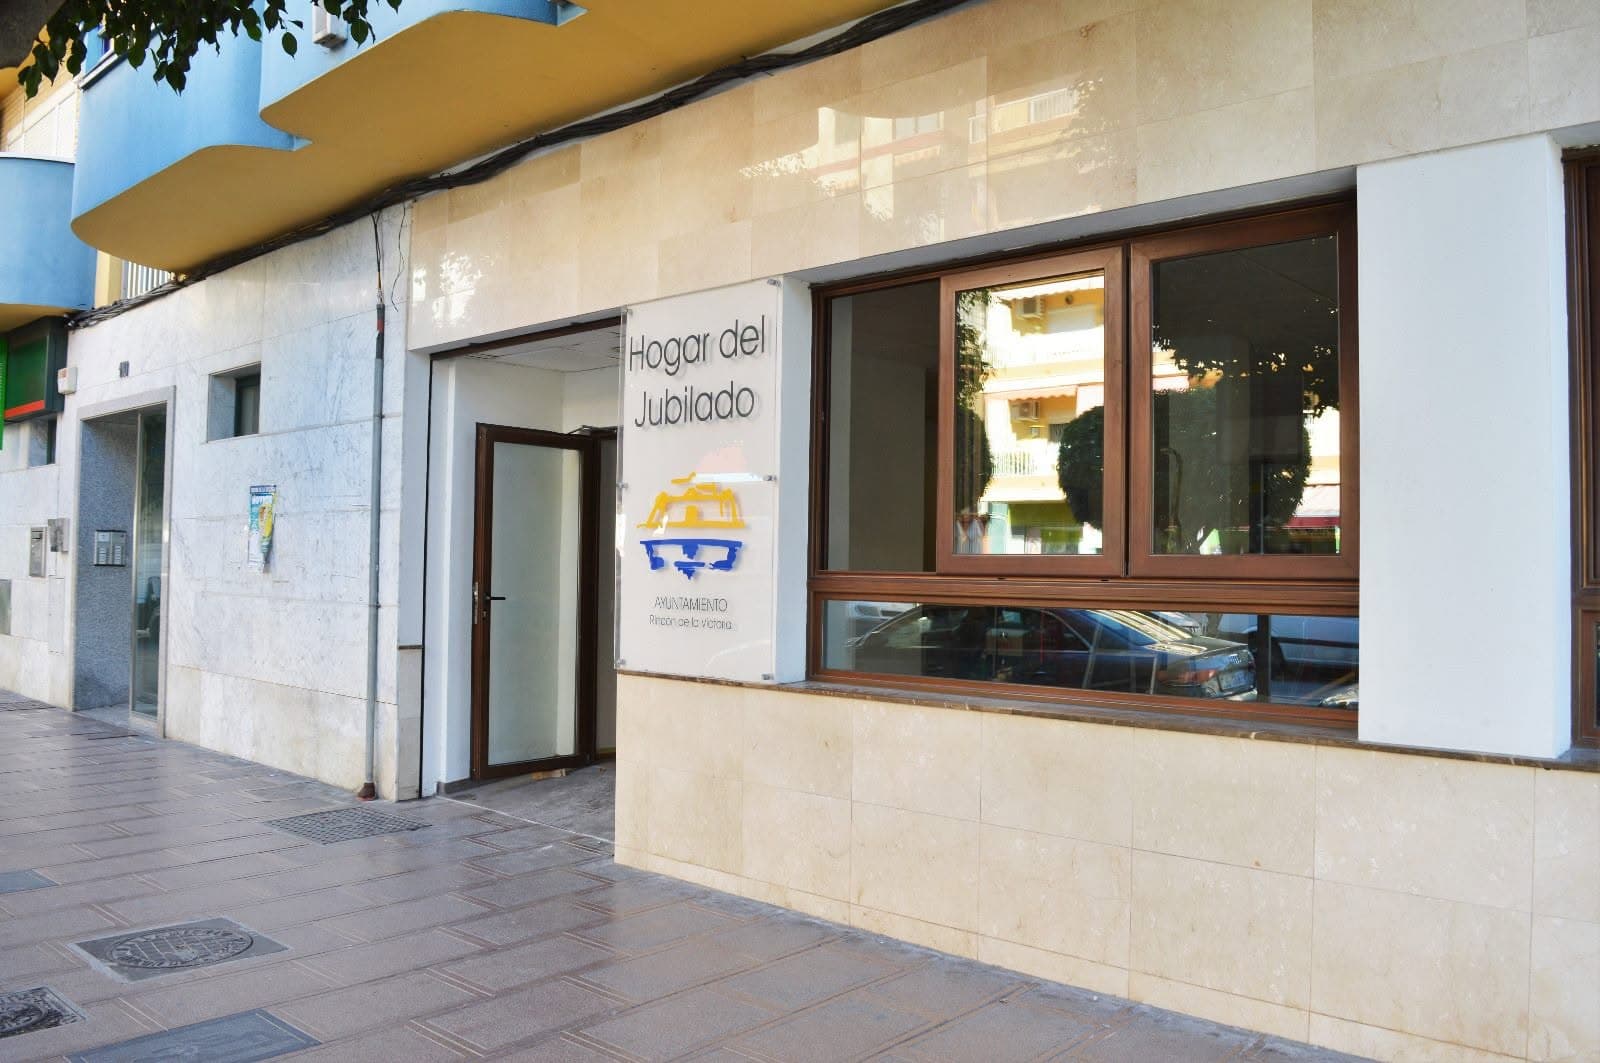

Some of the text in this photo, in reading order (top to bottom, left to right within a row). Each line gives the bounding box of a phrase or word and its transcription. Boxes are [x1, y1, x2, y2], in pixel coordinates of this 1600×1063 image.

[629, 315, 765, 376] Hogar del
[634, 380, 755, 428] Jubilado
[654, 596, 728, 612] AYUNTAMIENTO
[678, 616, 690, 627] de
[691, 617, 699, 628] la
